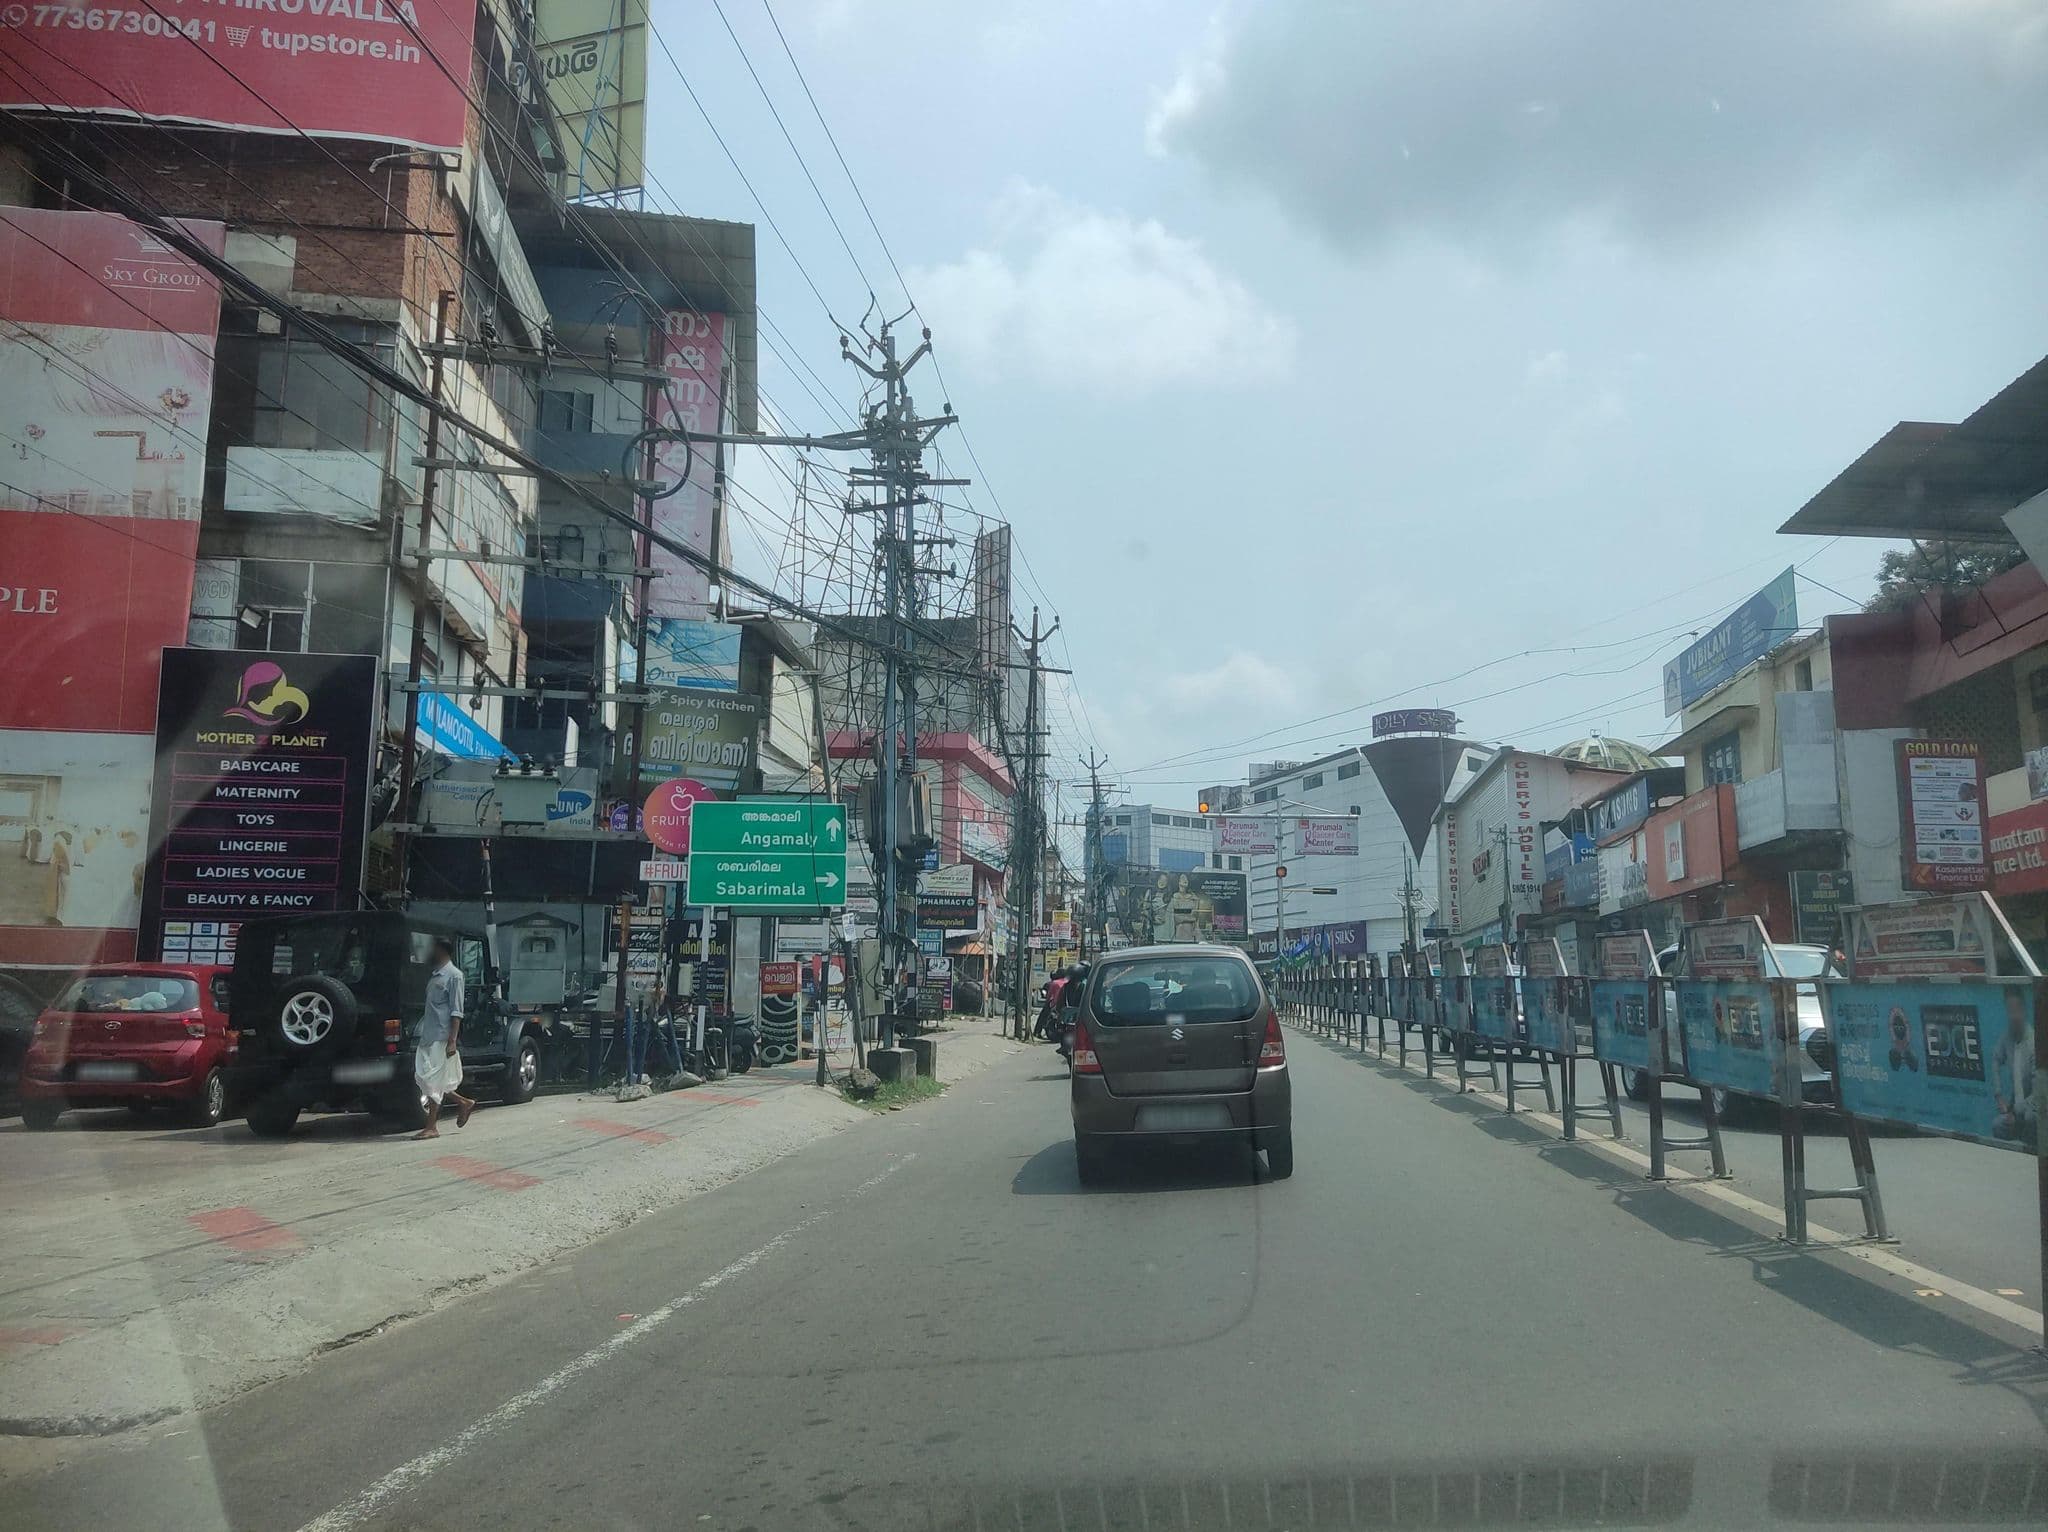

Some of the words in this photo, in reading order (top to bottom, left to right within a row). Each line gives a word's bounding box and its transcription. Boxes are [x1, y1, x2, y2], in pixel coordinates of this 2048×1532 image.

[33, 5, 216, 43] 7736730041
[260, 27, 420, 64] tupstore.in
[670, 695, 706, 709] Spicy
[707, 699, 755, 713] Kitchen
[1375, 711, 1409, 735] JOLLY
[196, 732, 255, 745] MOTHER
[272, 735, 327, 748] PLANET
[1905, 743, 1940, 755] GOLD
[1943, 743, 1978, 756] LOAN
[220, 759, 300, 773] BABYCARE
[216, 786, 300, 799] MATERNITY
[237, 814, 275, 825] TOYS
[569, 817, 592, 826] India
[651, 815, 691, 826] FRUIT
[741, 811, 801, 823] അങ്കമാലി
[1312, 823, 1343, 831] Parumala
[219, 841, 288, 852] LINGERIE
[741, 832, 818, 850] Angamaly
[196, 867, 250, 878] LADIES
[254, 868, 306, 879] VOGUE
[717, 860, 782, 873] ശബരിമല
[716, 881, 806, 896] Sabarimala
[187, 893, 246, 904] BEAUTY
[249, 895, 259, 905] &
[264, 895, 313, 906] FANCY
[923, 898, 966, 906] PHARMACY
[687, 922, 717, 938] AC
